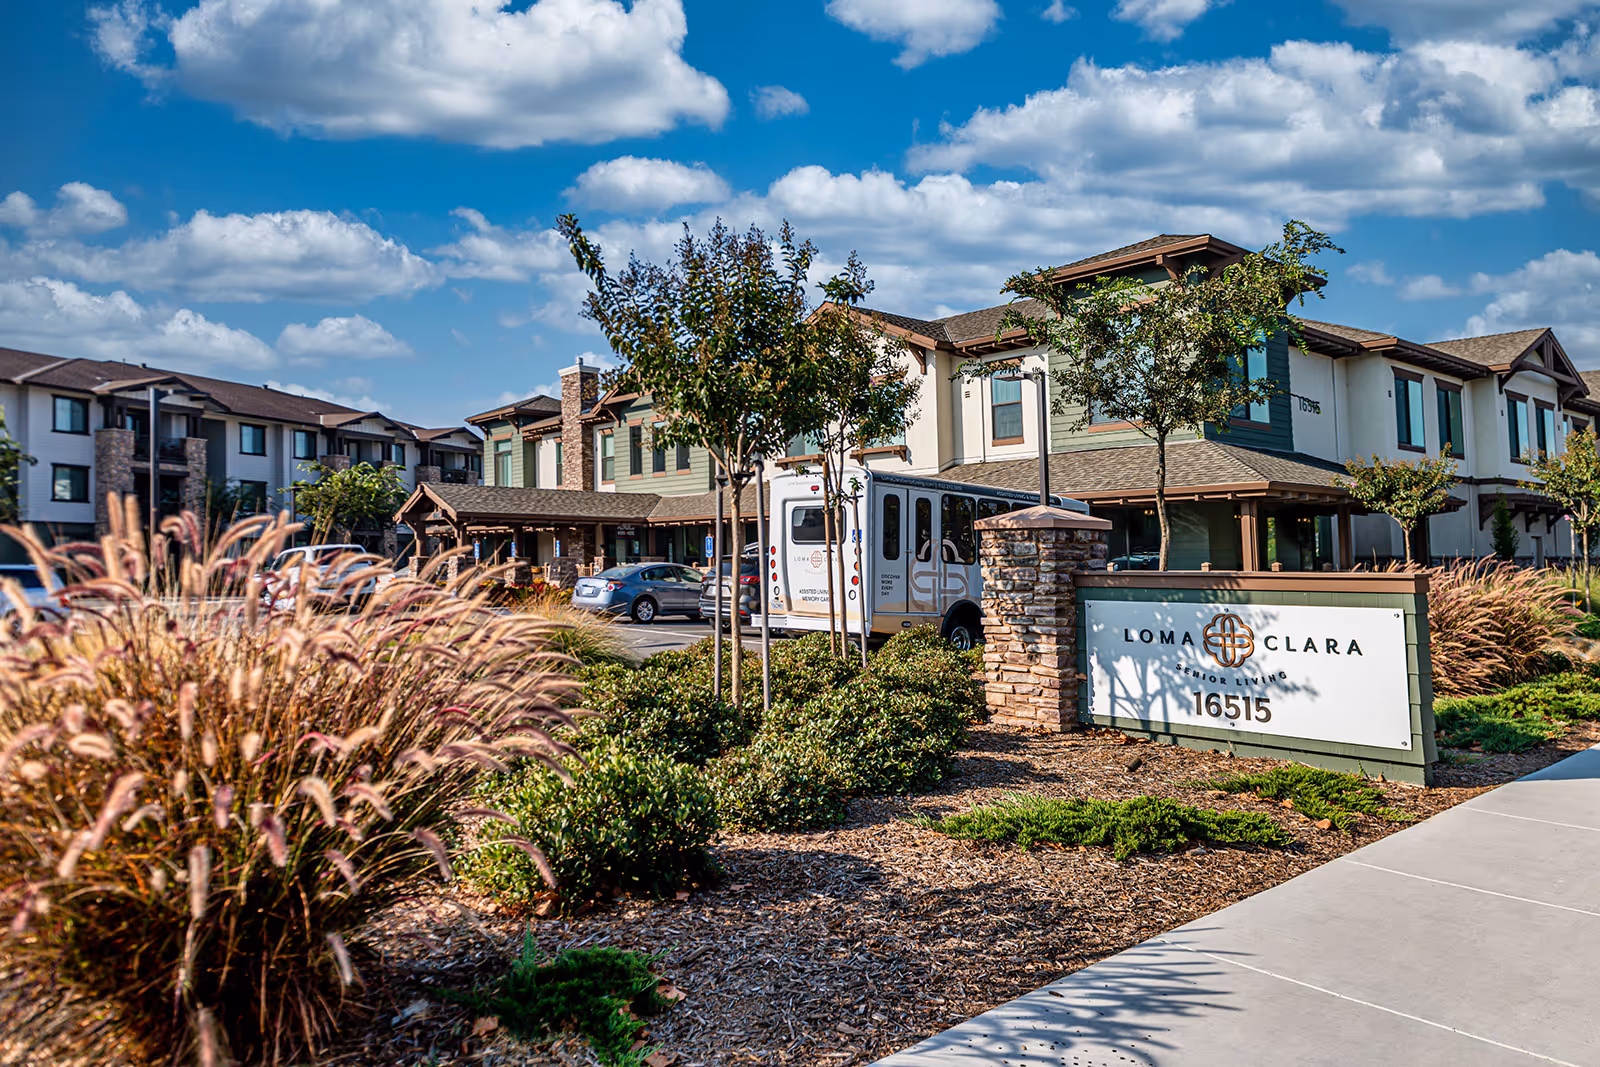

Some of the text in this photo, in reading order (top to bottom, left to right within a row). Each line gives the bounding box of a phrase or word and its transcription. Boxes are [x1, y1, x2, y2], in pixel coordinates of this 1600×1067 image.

[1123, 627, 1364, 657] LOMA CLARA
[1175, 663, 1288, 687] SENIOR LIVING
[1192, 690, 1273, 724] 16515
